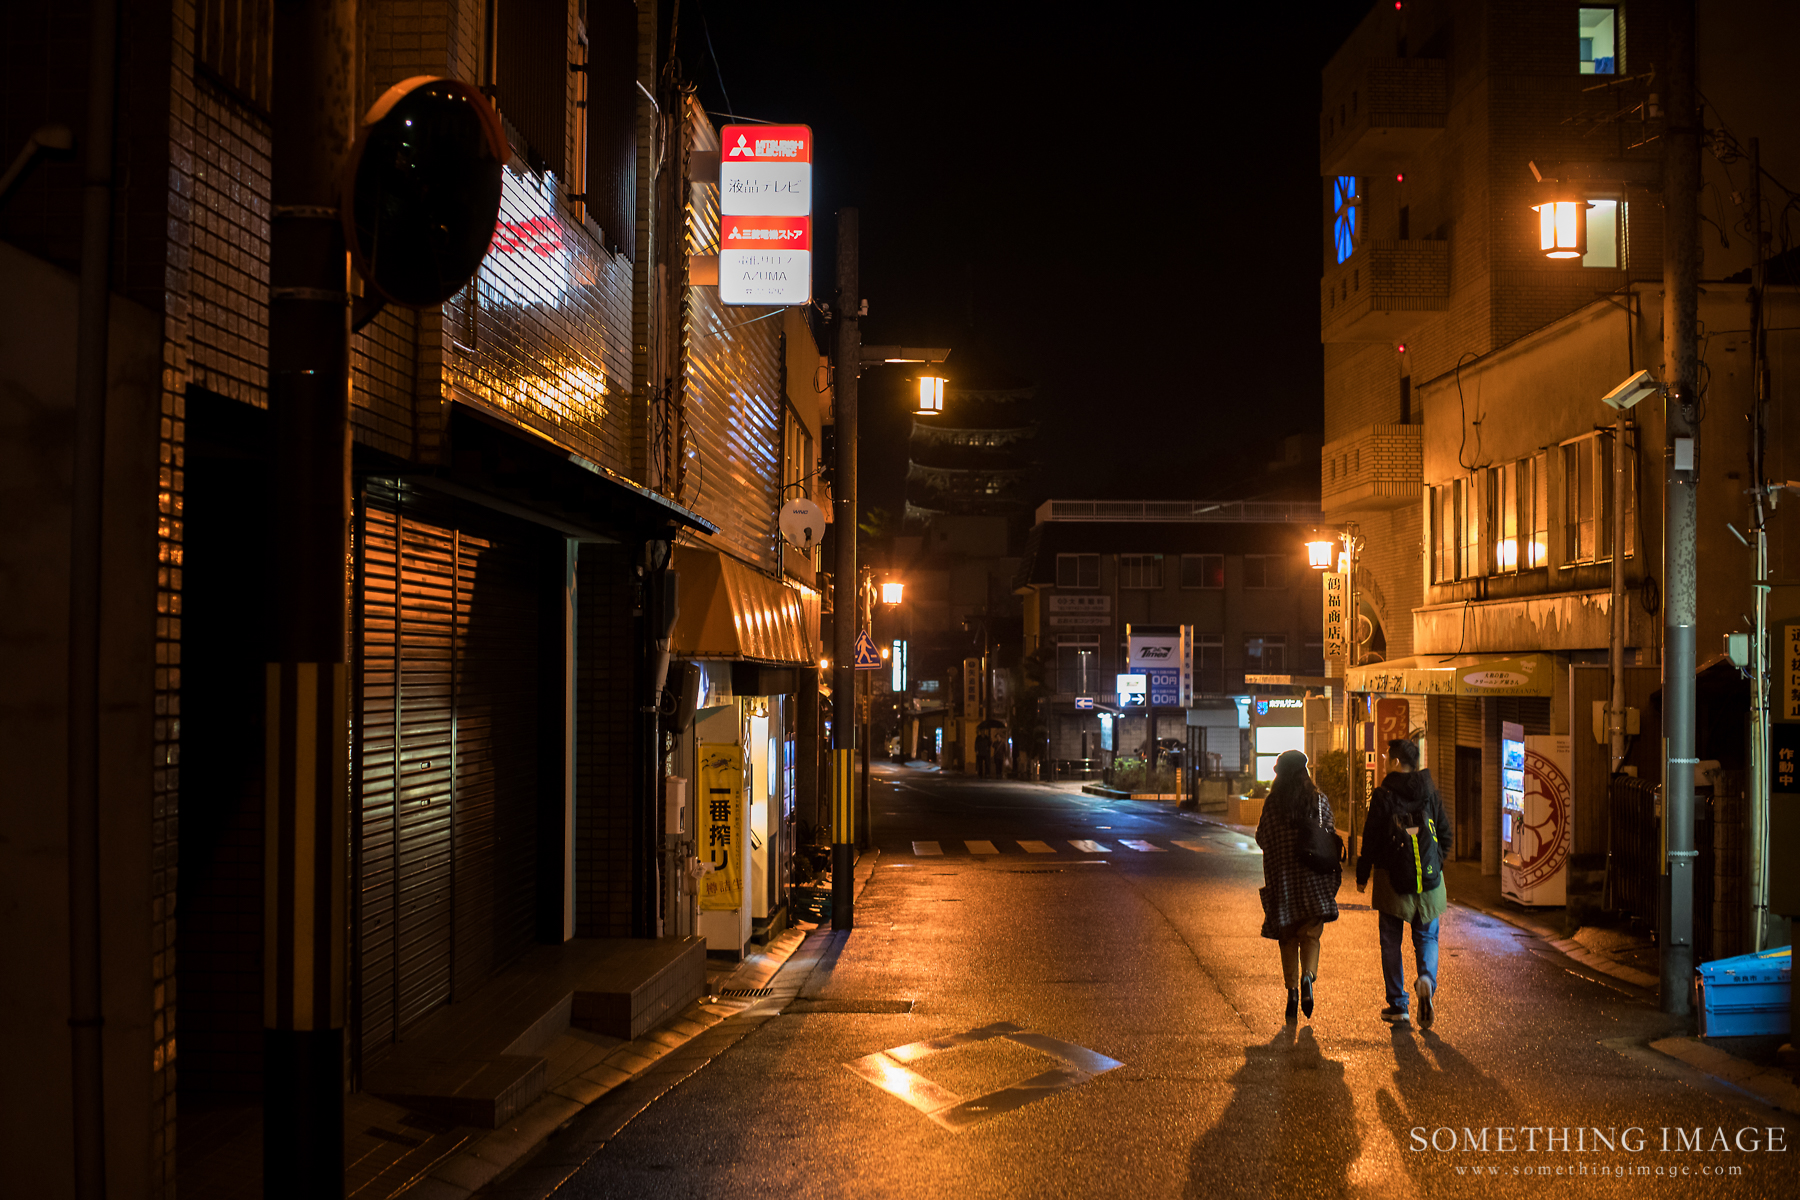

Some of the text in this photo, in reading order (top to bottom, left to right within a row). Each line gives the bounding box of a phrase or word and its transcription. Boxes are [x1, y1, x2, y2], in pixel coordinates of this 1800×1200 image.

[728, 179, 802, 193] 液晶テレビ
[1140, 647, 1172, 659] Times
[1779, 748, 1795, 787] 作動中
[710, 788, 731, 871] 一番搾り
